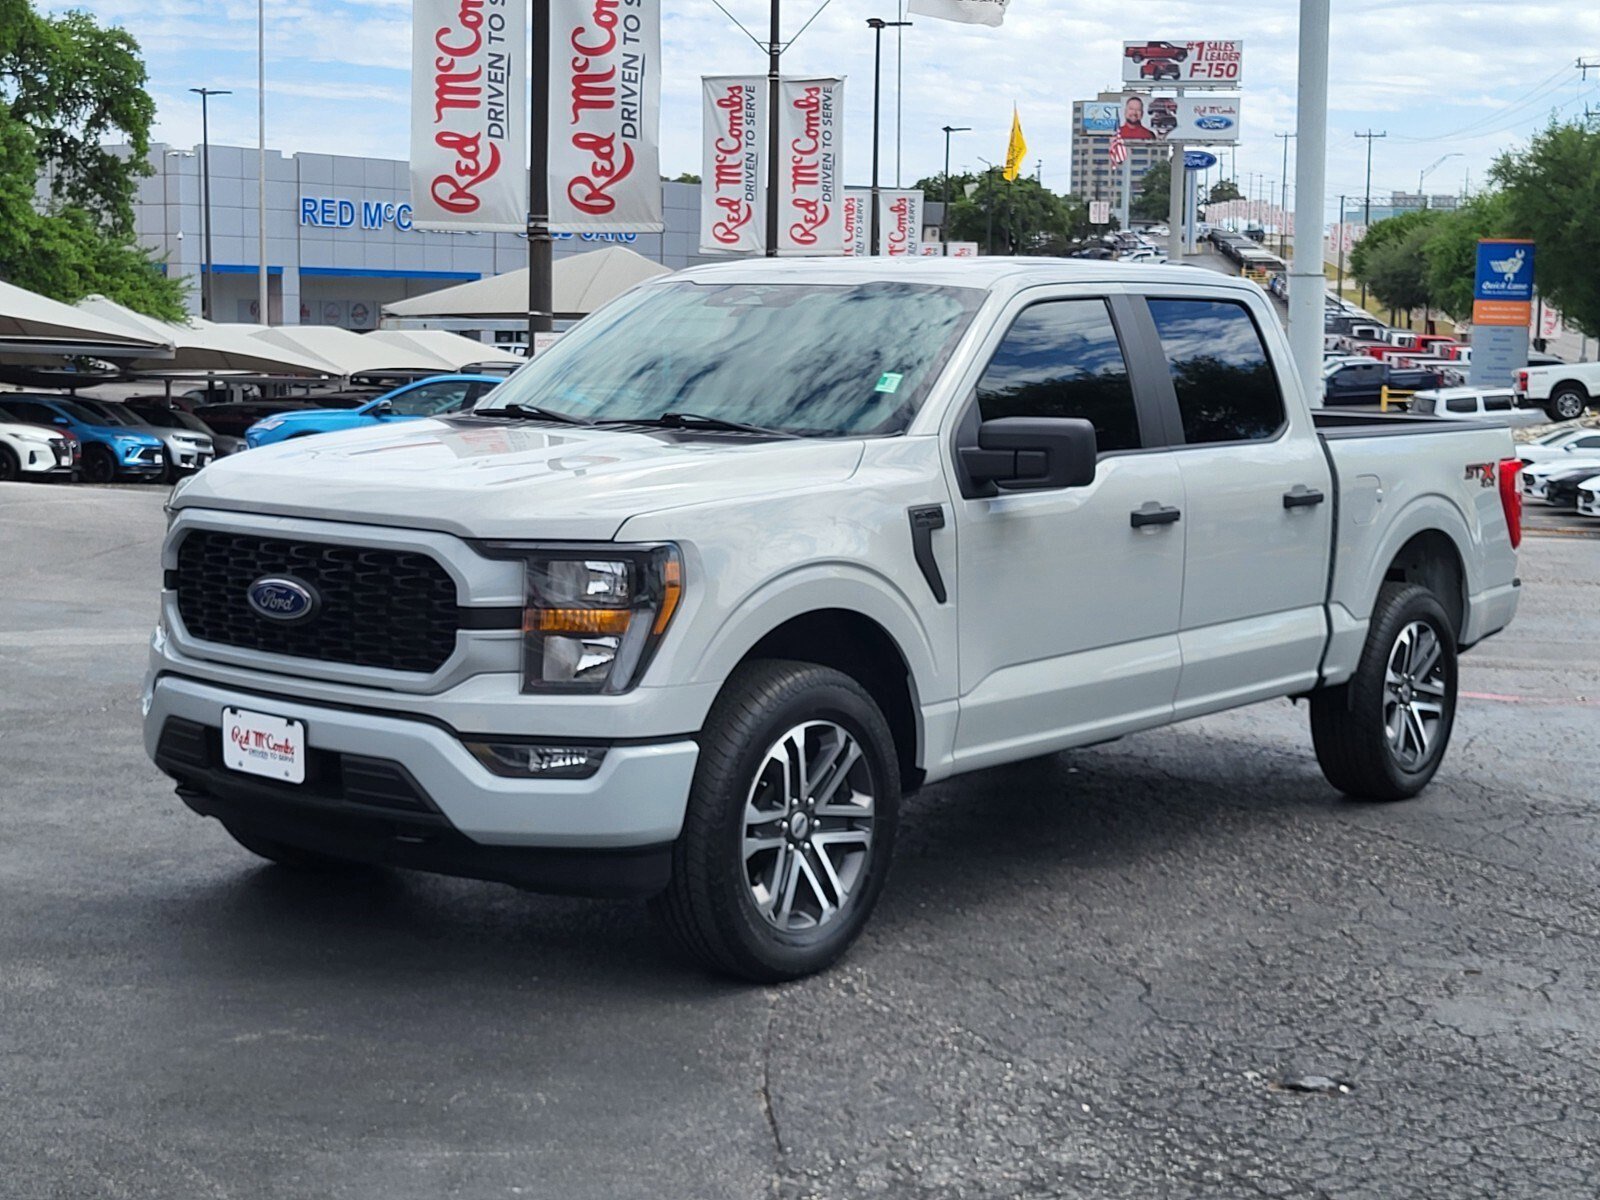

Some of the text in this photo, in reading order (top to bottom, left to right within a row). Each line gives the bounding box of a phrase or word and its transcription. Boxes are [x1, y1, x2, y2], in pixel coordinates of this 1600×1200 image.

[488, 13, 505, 45] TO
[623, 14, 641, 45] TO
[1187, 41, 1235, 61] #1 SALES
[1205, 52, 1240, 61] LEADER
[1189, 63, 1238, 78] F-150
[488, 53, 505, 139] DRIVEN
[621, 53, 640, 139] DRIVEN
[745, 85, 756, 202] DRIVEN TO SERVE
[822, 86, 833, 203] DRIVEN TO SERVE
[431, 131, 501, 214] Red
[567, 132, 635, 215] Red
[712, 85, 752, 244] Red McCombs
[790, 86, 830, 245] Red McCombs
[302, 198, 355, 227] RED
[1464, 462, 1495, 480] STX
[260, 587, 295, 611] Ford
[231, 725, 249, 751] Red
